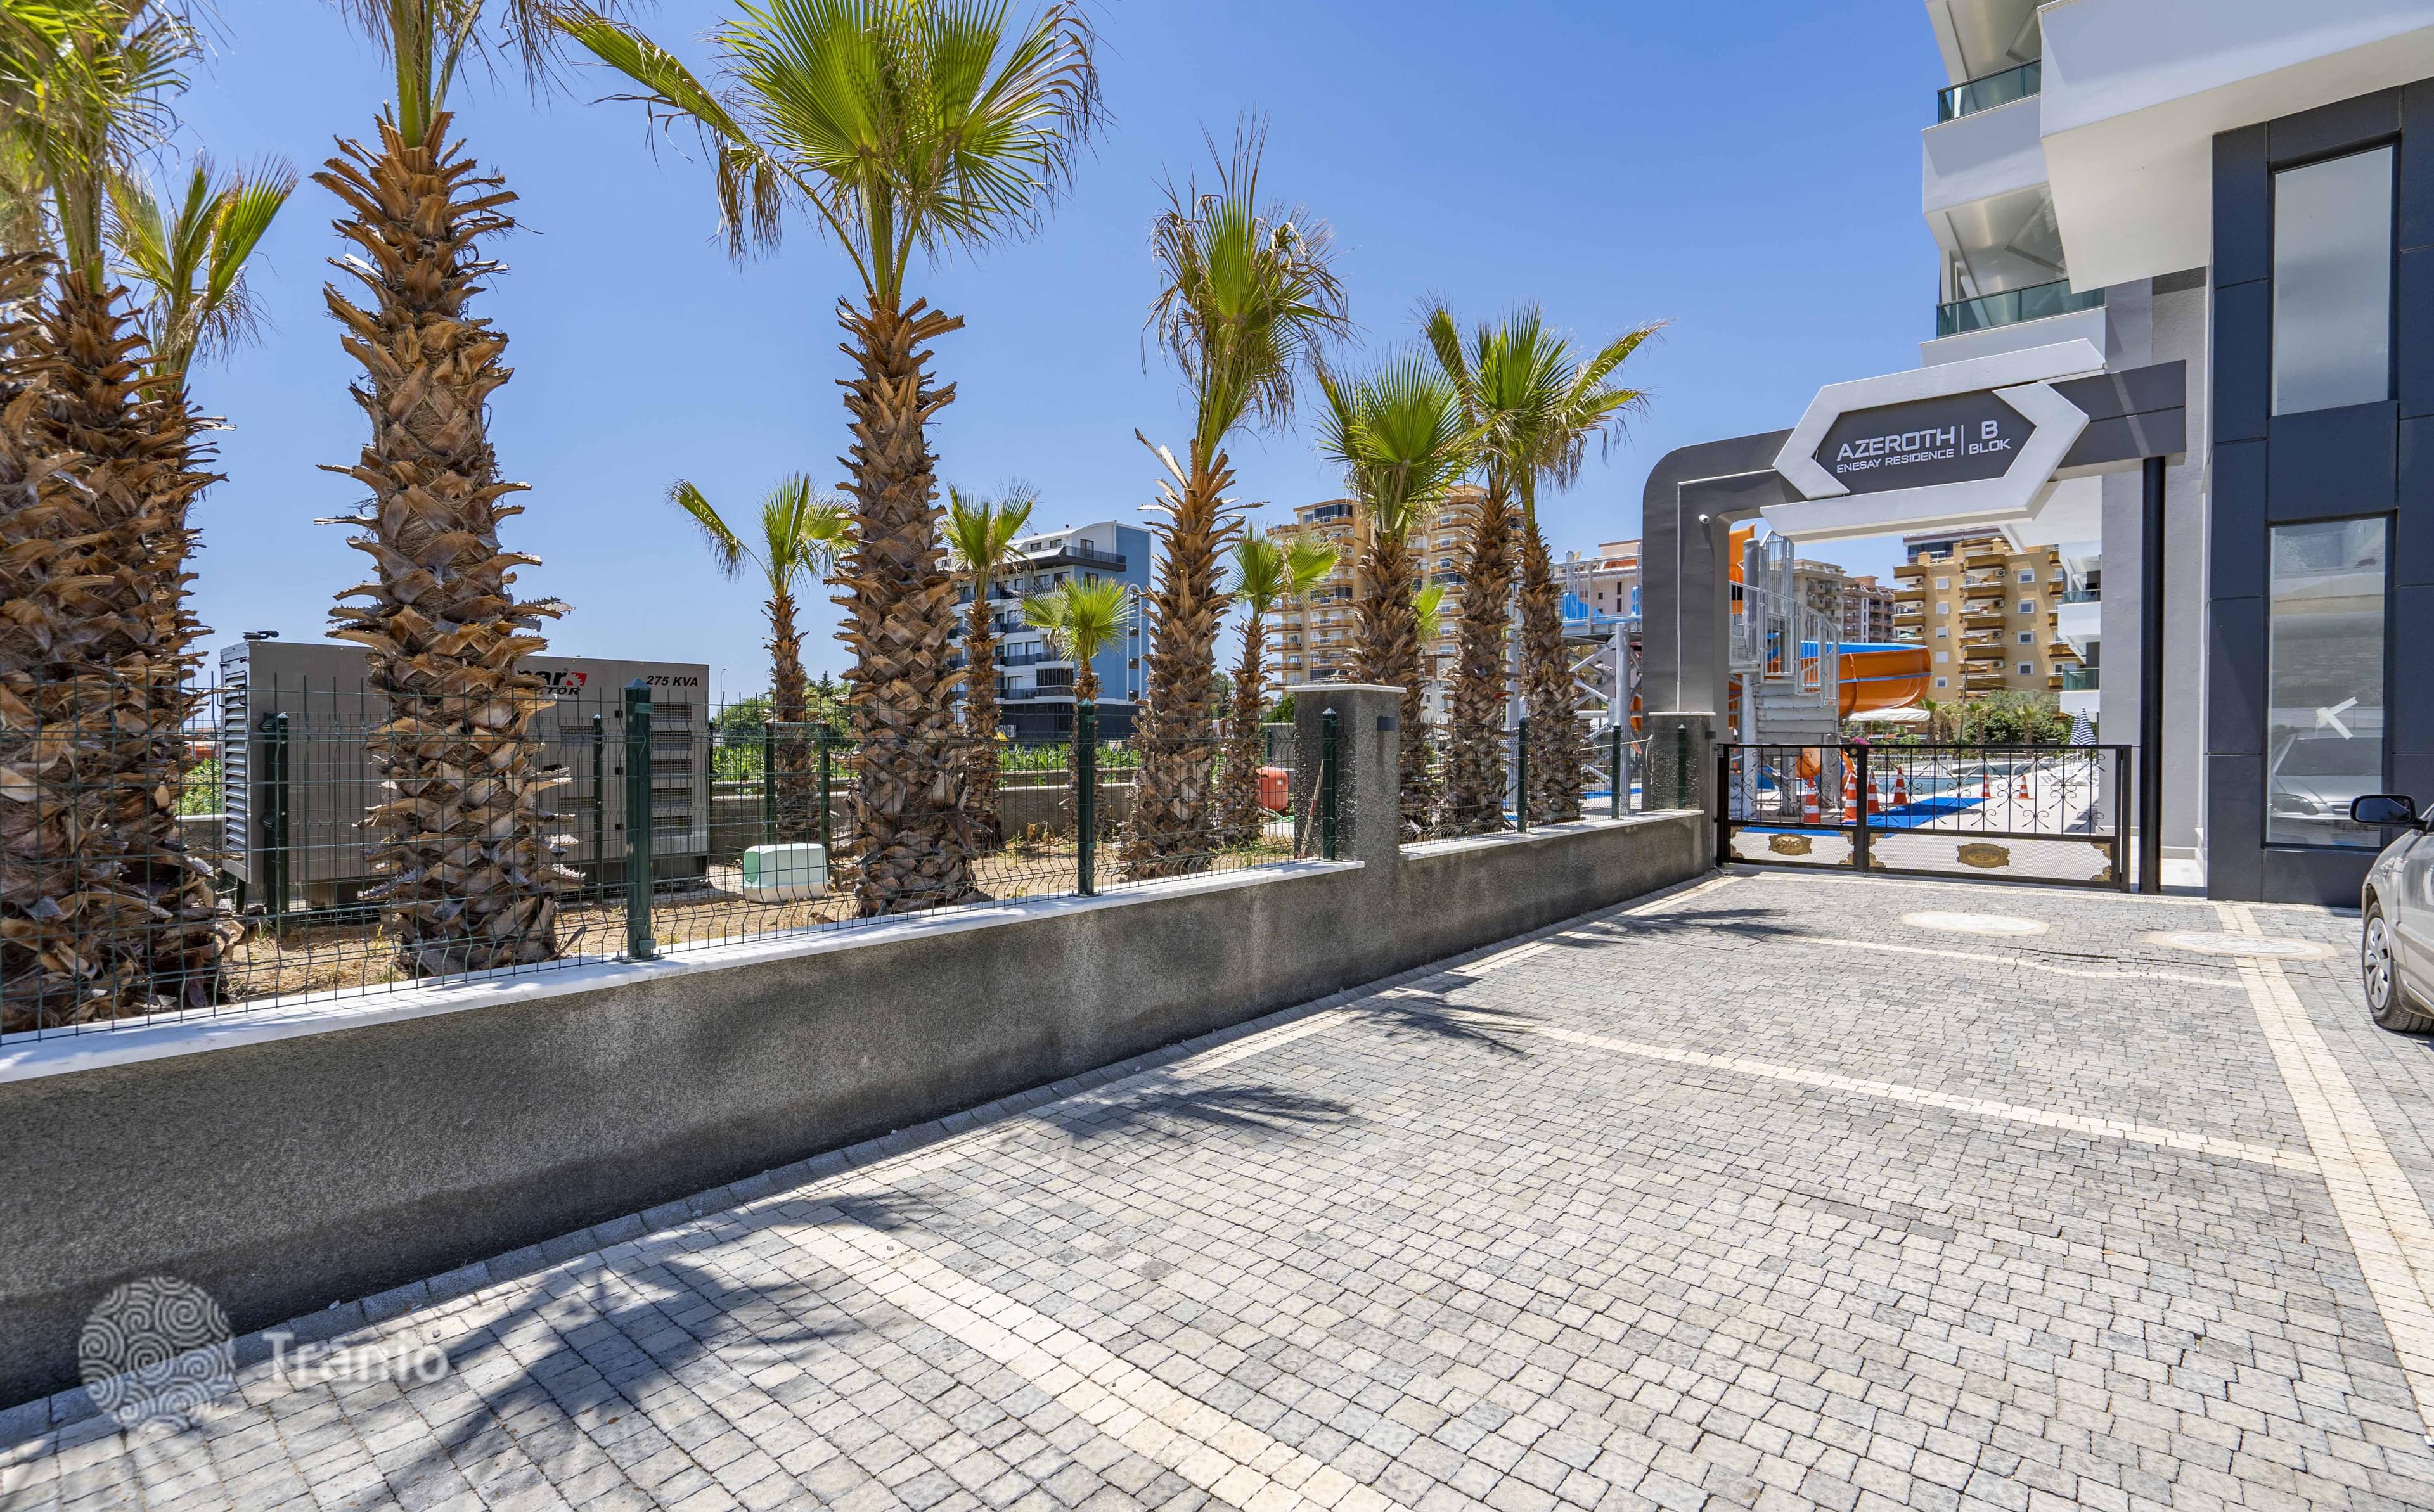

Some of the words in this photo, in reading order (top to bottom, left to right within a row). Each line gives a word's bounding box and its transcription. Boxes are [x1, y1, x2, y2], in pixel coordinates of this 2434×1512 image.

[1981, 420, 1999, 440] B
[1837, 426, 1955, 461] AZEROTH
[1969, 438, 2011, 455] BLOK
[1837, 458, 1881, 473] ENESAY
[1885, 448, 1955, 466] RESIDENCE
[646, 676, 669, 686] 275
[673, 676, 698, 686] KVA
